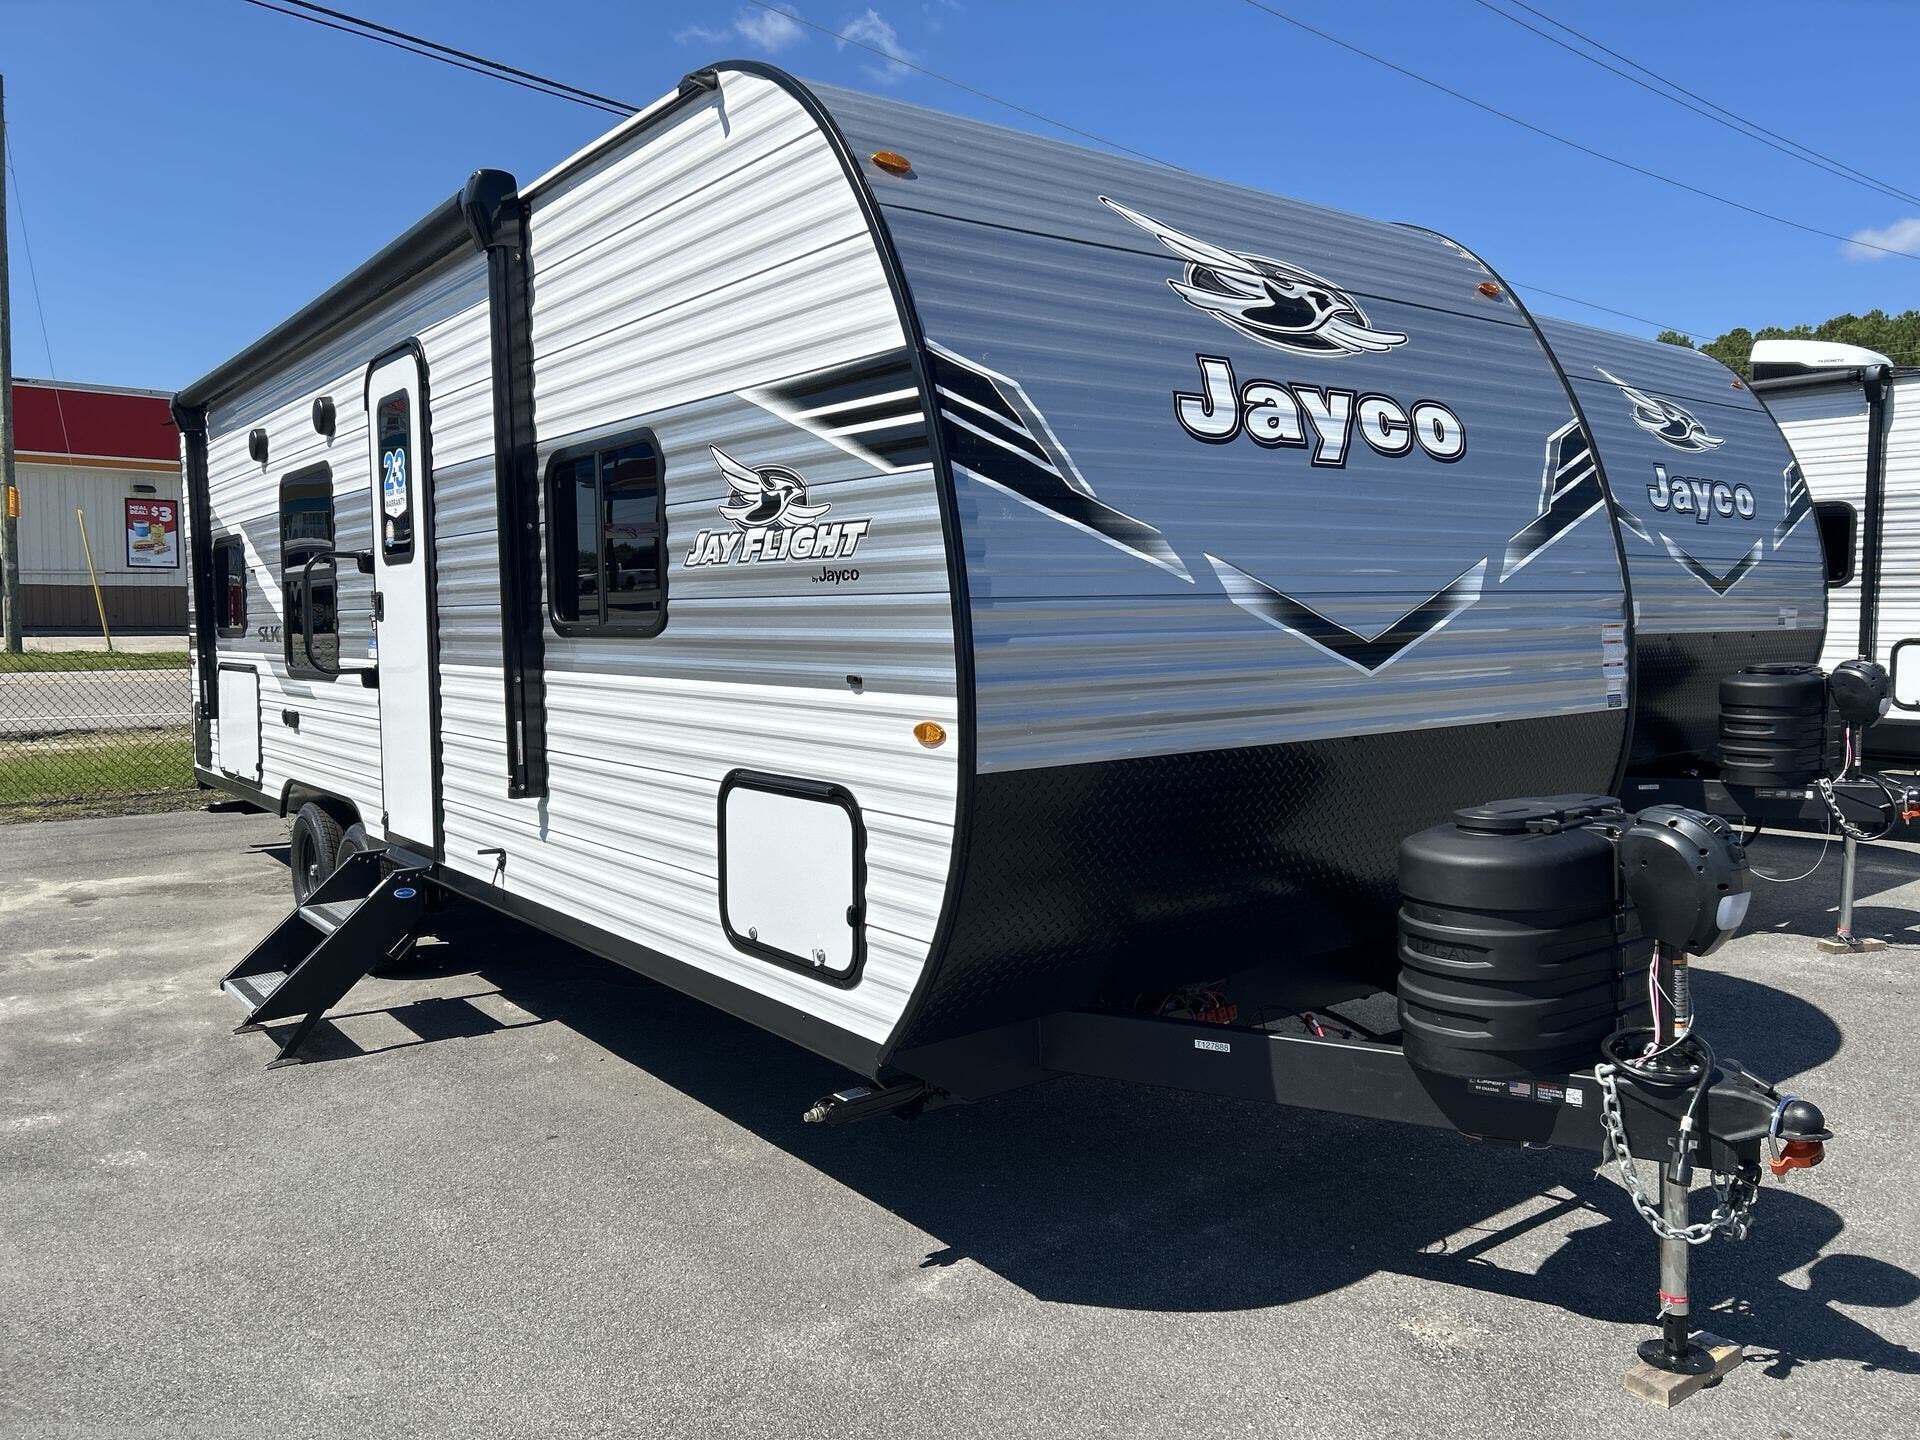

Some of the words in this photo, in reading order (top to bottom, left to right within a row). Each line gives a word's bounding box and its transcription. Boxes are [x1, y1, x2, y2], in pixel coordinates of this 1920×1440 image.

[1173, 354, 1466, 469] Jayco
[1646, 463, 1756, 525] Jayco
[151, 506, 172, 522] $3
[683, 529, 743, 568] JAY
[736, 517, 872, 565] FLIGHT
[818, 566, 860, 585] Jayco
[258, 626, 282, 642] SLK
